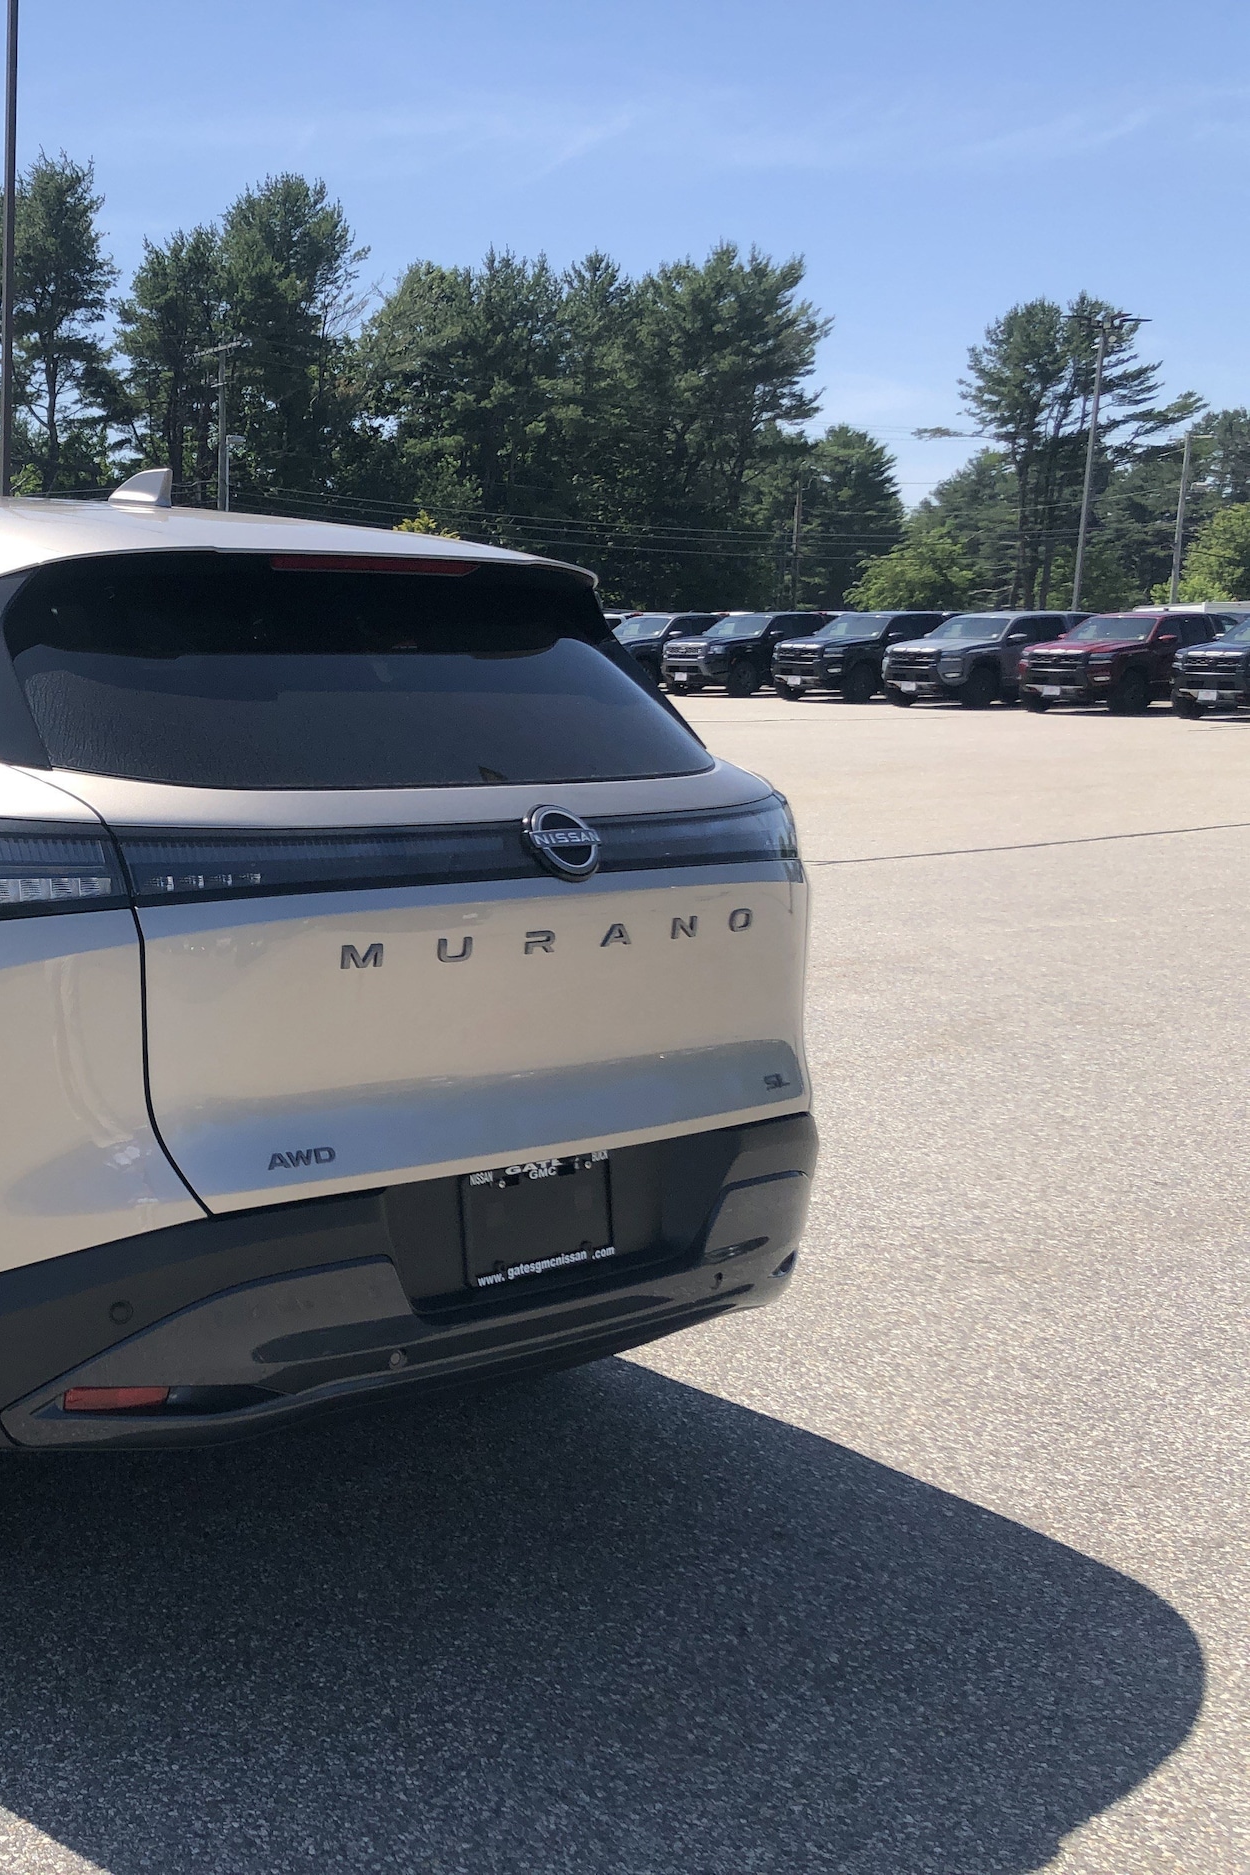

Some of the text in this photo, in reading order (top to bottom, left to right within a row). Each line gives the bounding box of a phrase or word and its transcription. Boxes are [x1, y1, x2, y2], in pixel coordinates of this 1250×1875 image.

[533, 830, 601, 845] NISSAN
[340, 908, 754, 969] MURANO
[267, 1146, 336, 1171] AWD
[469, 1170, 494, 1186] NISSAN
[528, 1166, 558, 1180] GMC
